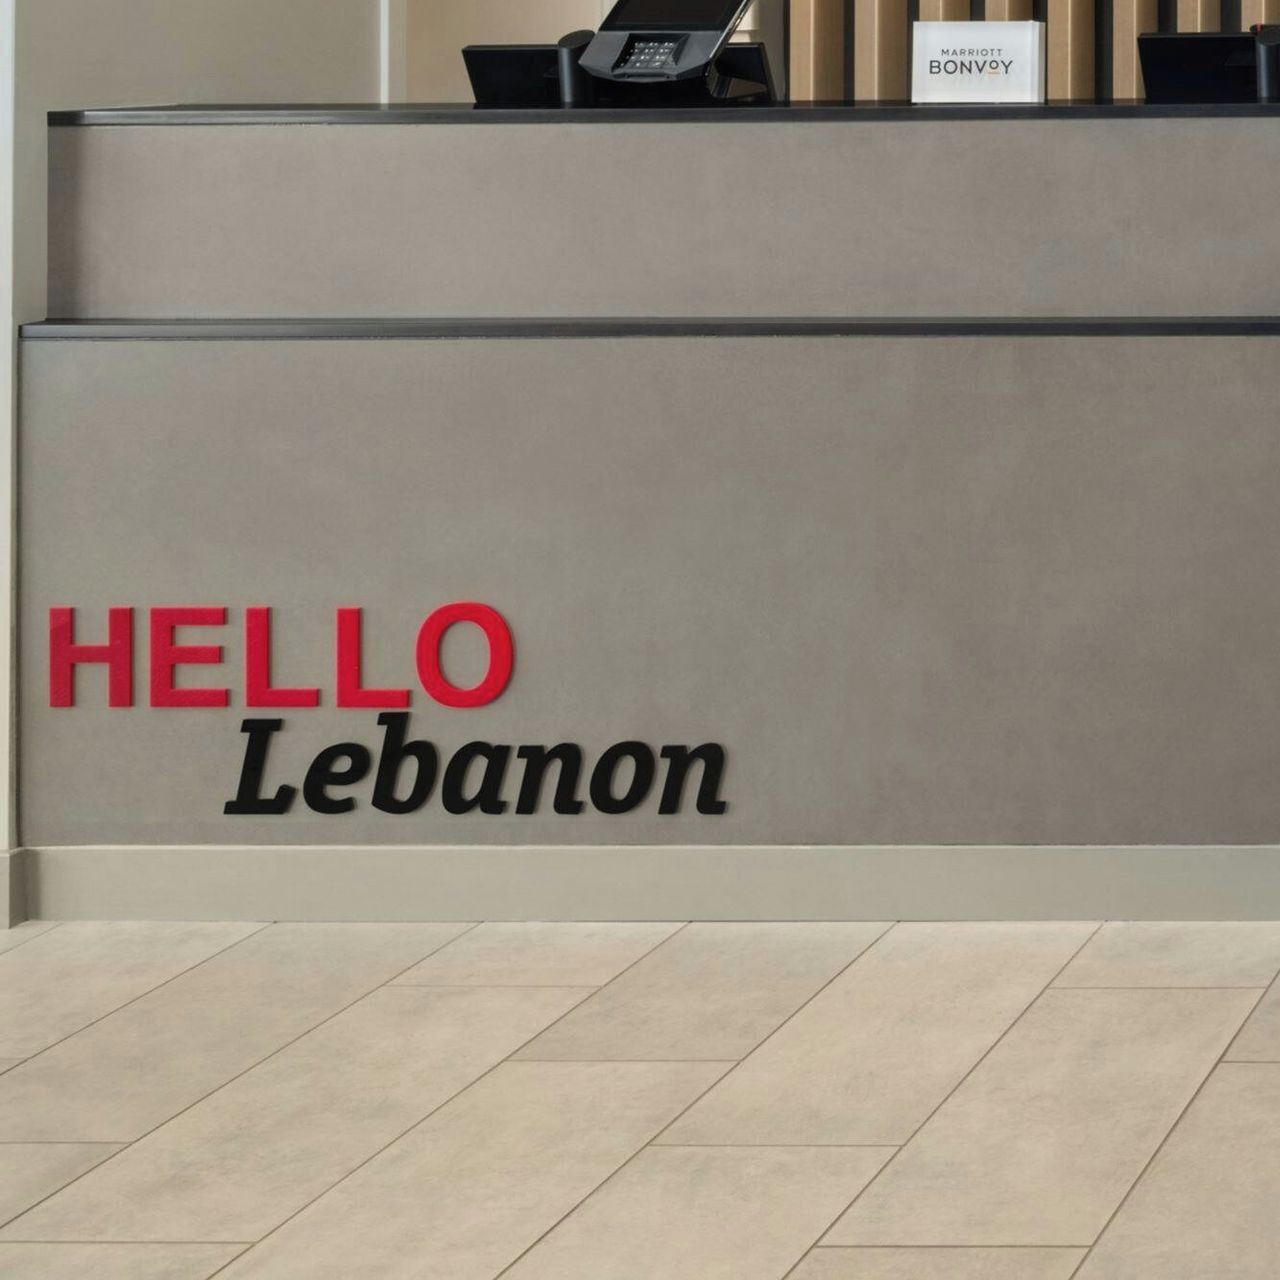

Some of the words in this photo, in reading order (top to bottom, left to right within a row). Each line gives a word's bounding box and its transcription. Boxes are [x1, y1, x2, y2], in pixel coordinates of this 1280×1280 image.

[929, 59, 1013, 75] BONVOY
[941, 49, 1002, 57] MARRIOTT
[49, 601, 516, 709] HELLO
[223, 711, 730, 816] Lebanon
